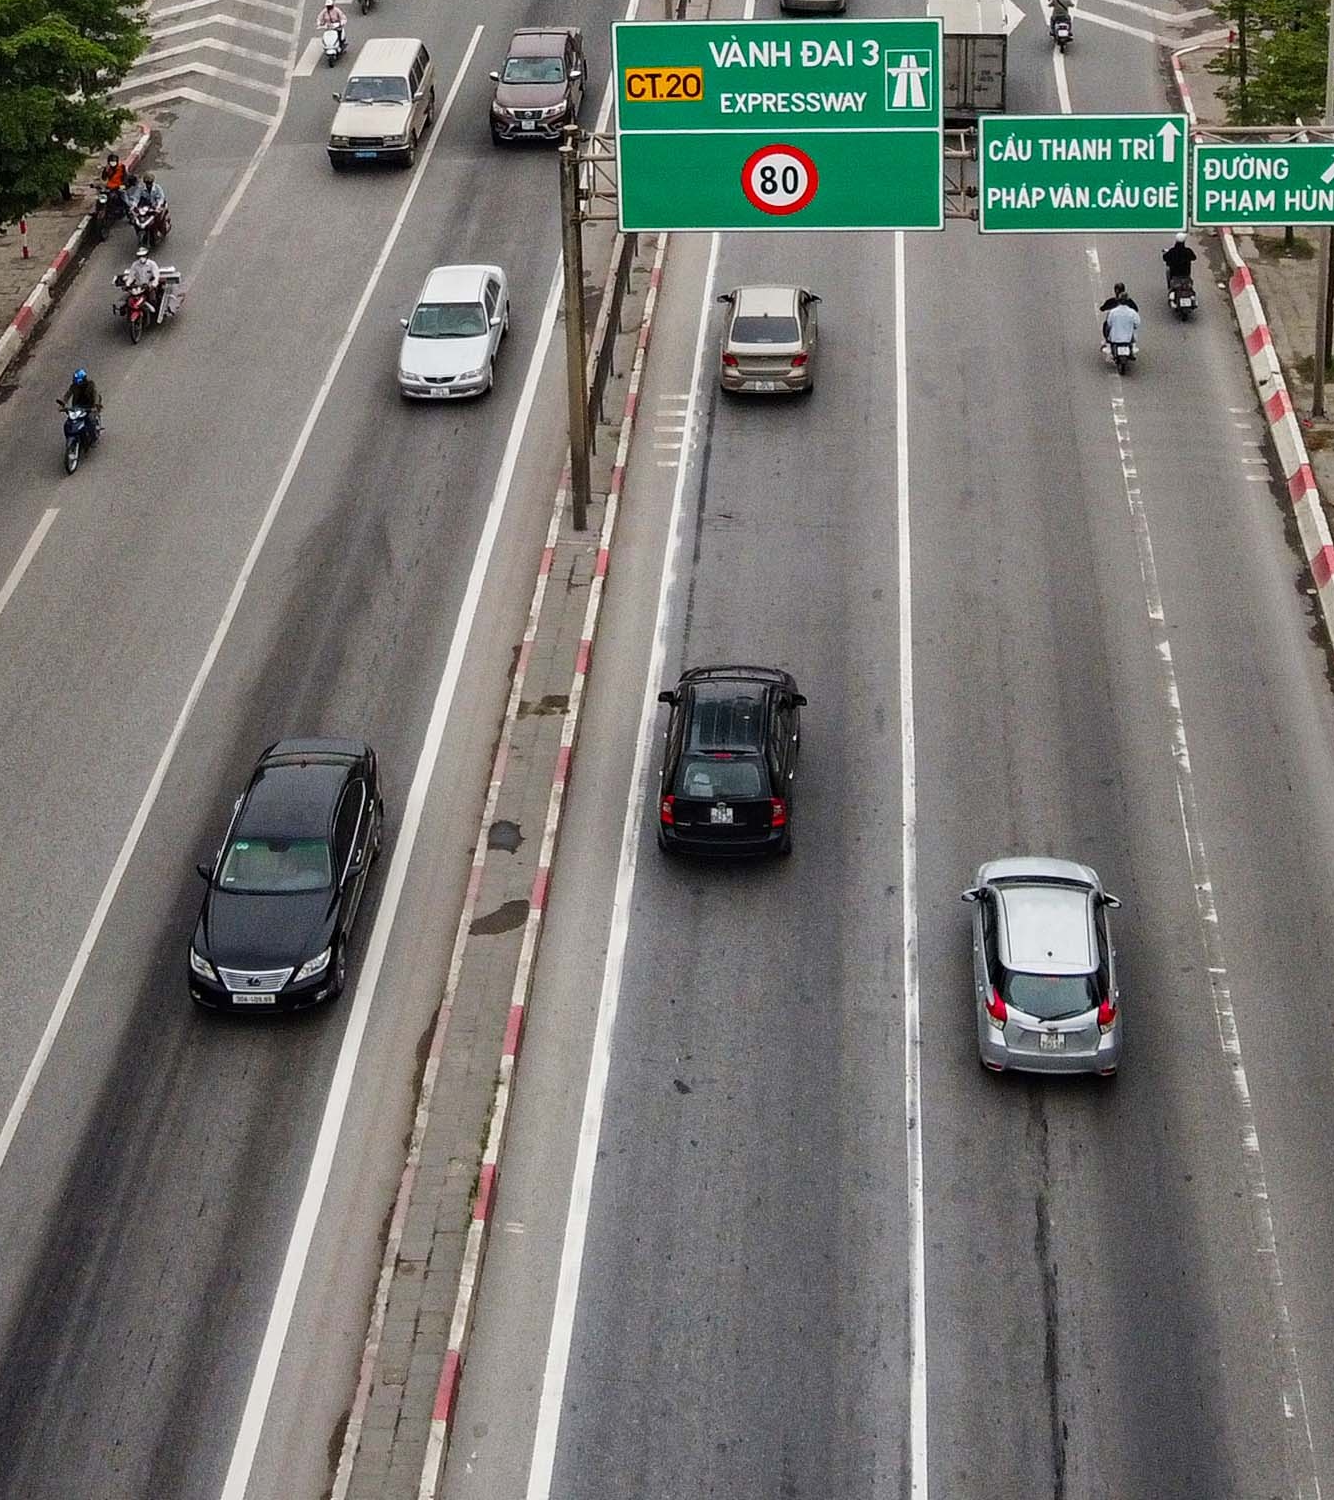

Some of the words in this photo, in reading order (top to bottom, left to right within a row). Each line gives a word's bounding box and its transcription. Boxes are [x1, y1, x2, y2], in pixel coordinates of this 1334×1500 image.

[709, 35, 791, 68] VÀNH
[800, 39, 853, 67] ĐAI
[861, 39, 880, 66] 3
[627, 73, 701, 99] CT.20
[720, 92, 867, 113] EXPRESSWAY
[988, 132, 1032, 161] CẦU
[1038, 139, 1112, 161] THANH
[1118, 134, 1155, 160] TRÌ
[760, 165, 799, 195] 80
[1203, 152, 1290, 181] ĐƯỜNG
[987, 182, 1045, 209] PHÁP
[1205, 189, 1275, 216] PHẠM
